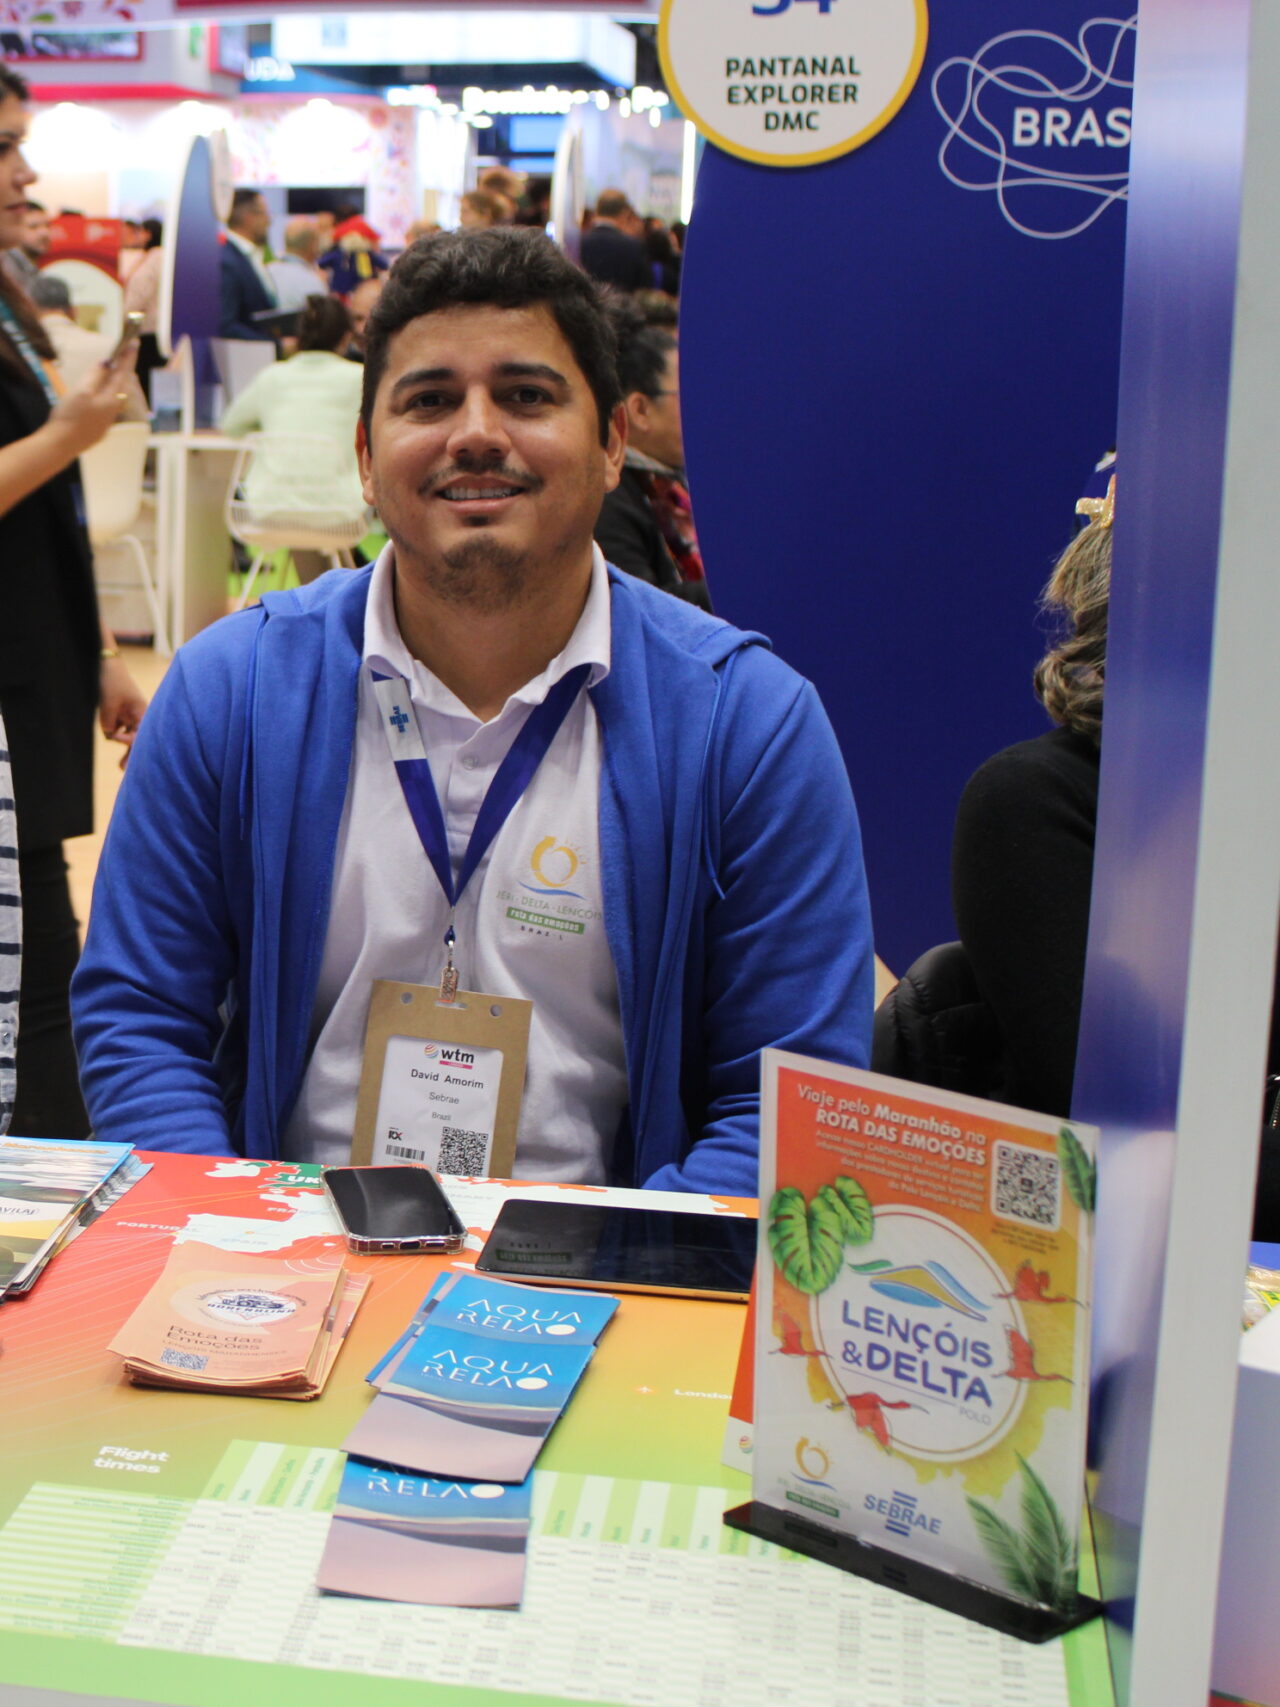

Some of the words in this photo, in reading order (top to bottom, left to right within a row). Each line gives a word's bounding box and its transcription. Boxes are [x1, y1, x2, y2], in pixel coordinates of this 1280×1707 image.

[725, 56, 862, 79] PANTANAL
[727, 82, 858, 105] EXPLORER
[763, 111, 820, 131] DMC
[441, 1048, 475, 1064] wtm
[411, 1068, 439, 1081] David
[444, 1075, 484, 1090] Amorim
[429, 1092, 460, 1105] Sebrae
[432, 1112, 452, 1122] Brazil
[797, 1083, 835, 1108] Viaje
[837, 1092, 871, 1117] pelo
[874, 1103, 963, 1140] Maranhão
[965, 1129, 987, 1145] na
[816, 1109, 860, 1133] ROTA
[864, 1119, 898, 1143] DAS
[466, 1298, 582, 1324] AQUA
[169, 1325, 218, 1341] Rota
[225, 1335, 263, 1344] das
[841, 1300, 993, 1368] LENÇÓIS
[432, 1349, 554, 1376] AQUA
[674, 1388, 733, 1401] Londo
[957, 1404, 992, 1427] POLO
[99, 1446, 170, 1462] Flight
[93, 1457, 161, 1474] times
[863, 1493, 943, 1536] SEBRAE
